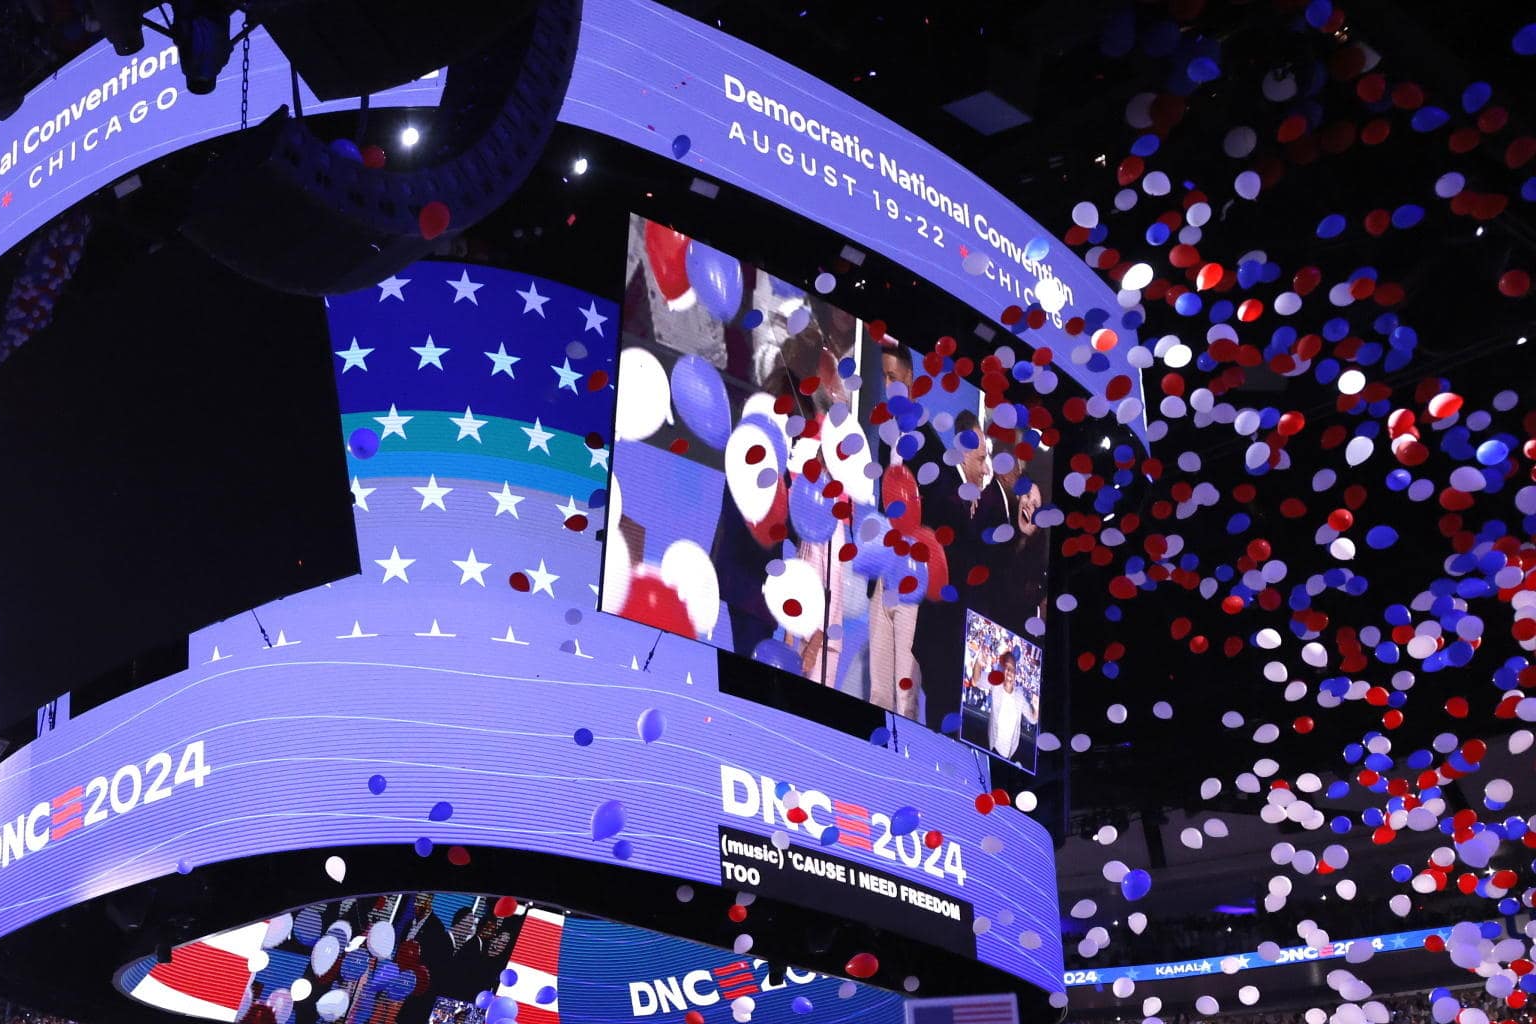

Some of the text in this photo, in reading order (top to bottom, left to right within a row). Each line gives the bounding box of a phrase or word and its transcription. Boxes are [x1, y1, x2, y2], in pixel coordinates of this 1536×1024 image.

[23, 45, 179, 156] Convention
[28, 86, 179, 189] CHICAGO
[723, 73, 875, 170] Democratic
[879, 152, 970, 229] National
[728, 120, 857, 197] AUGUST
[872, 189, 945, 248] 19-22
[83, 740, 212, 827] 2024
[721, 834, 961, 921] (music) 'CAUSE I NEED FREEDOM
[722, 861, 761, 886] TOO
[628, 969, 721, 1017] DNC
[1064, 971, 1098, 985] 024
[1155, 960, 1212, 977] KAMALA
